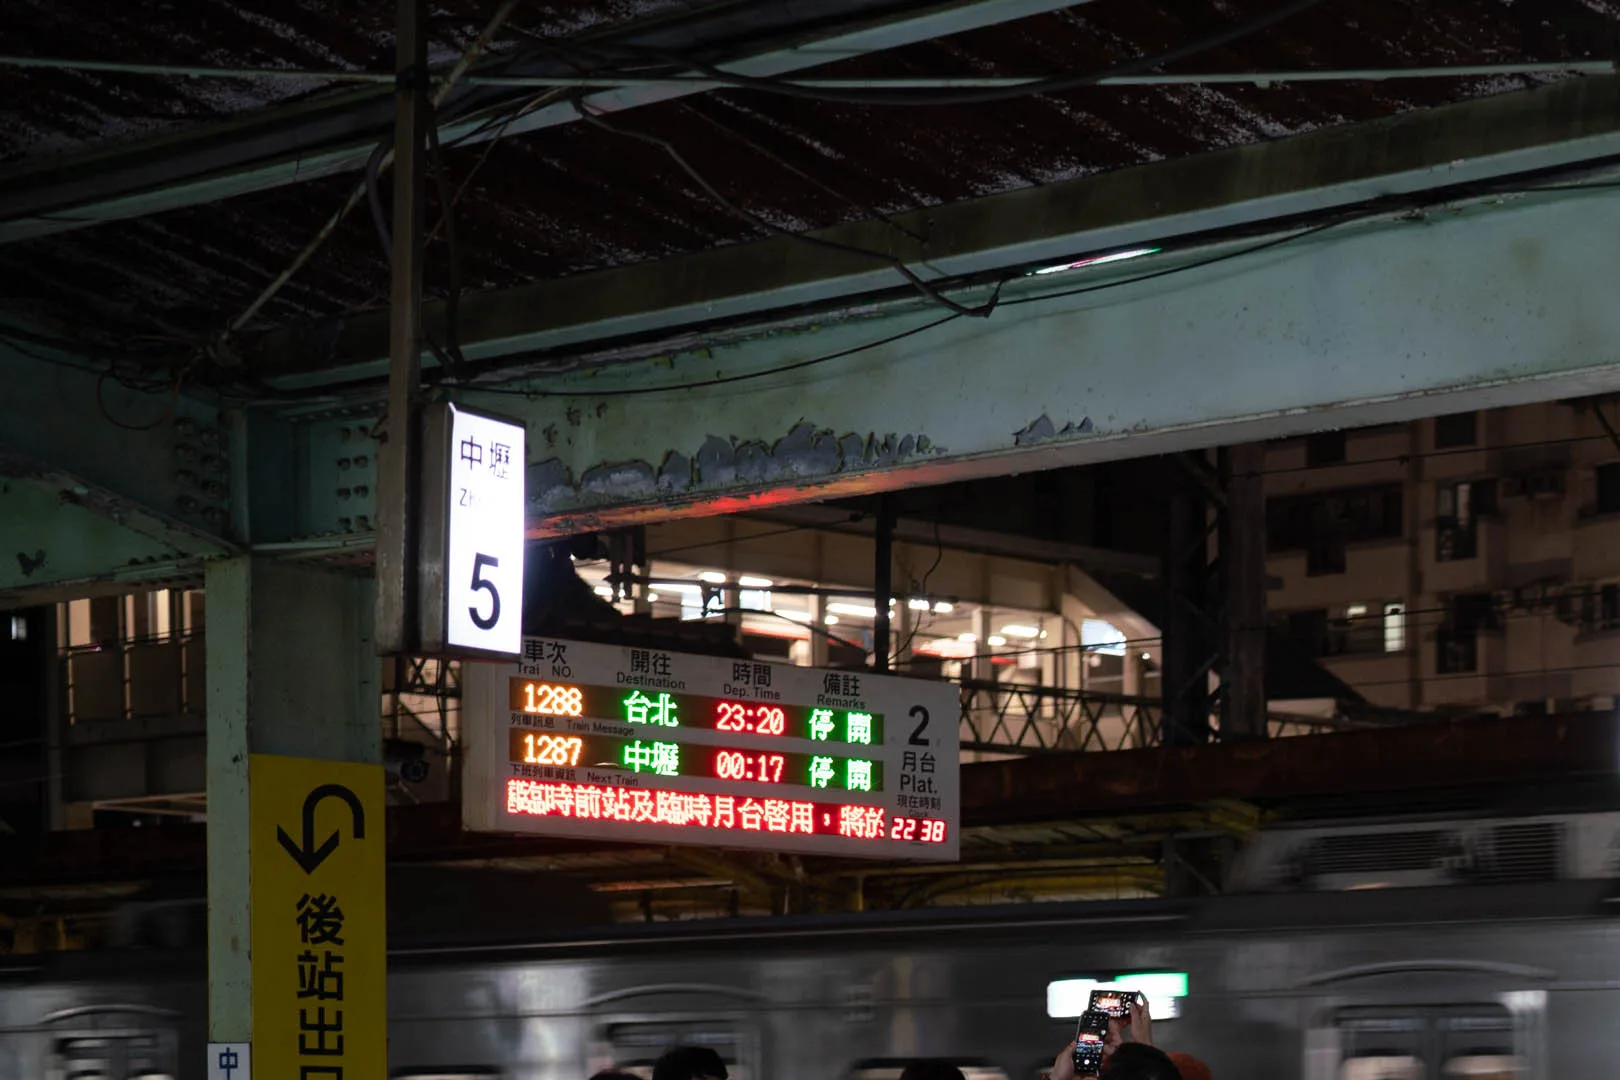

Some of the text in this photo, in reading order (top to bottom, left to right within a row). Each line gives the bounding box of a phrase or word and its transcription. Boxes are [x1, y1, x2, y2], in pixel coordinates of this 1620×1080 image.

[460, 436, 511, 480] 中壢
[469, 553, 500, 630] 5
[524, 639, 567, 664] 車次
[631, 649, 671, 676] 開往
[617, 671, 686, 690] Destination
[733, 662, 771, 688] 時間
[823, 672, 860, 697] 備註
[524, 682, 583, 716] 1288
[723, 684, 780, 700] Dep. Time
[817, 694, 866, 710] Remarks
[622, 689, 679, 727] 台北
[716, 701, 784, 735] 23:20
[566, 718, 590, 731] Train
[593, 722, 635, 737] Message
[908, 705, 930, 746] 2
[524, 733, 583, 766] 1287
[622, 739, 680, 776] 中壢
[902, 751, 936, 773] 月台
[587, 771, 612, 785] Next
[616, 774, 639, 787] Train
[716, 750, 784, 784] 00:17
[900, 774, 937, 794] Plat.
[897, 793, 941, 811] 現在時刻
